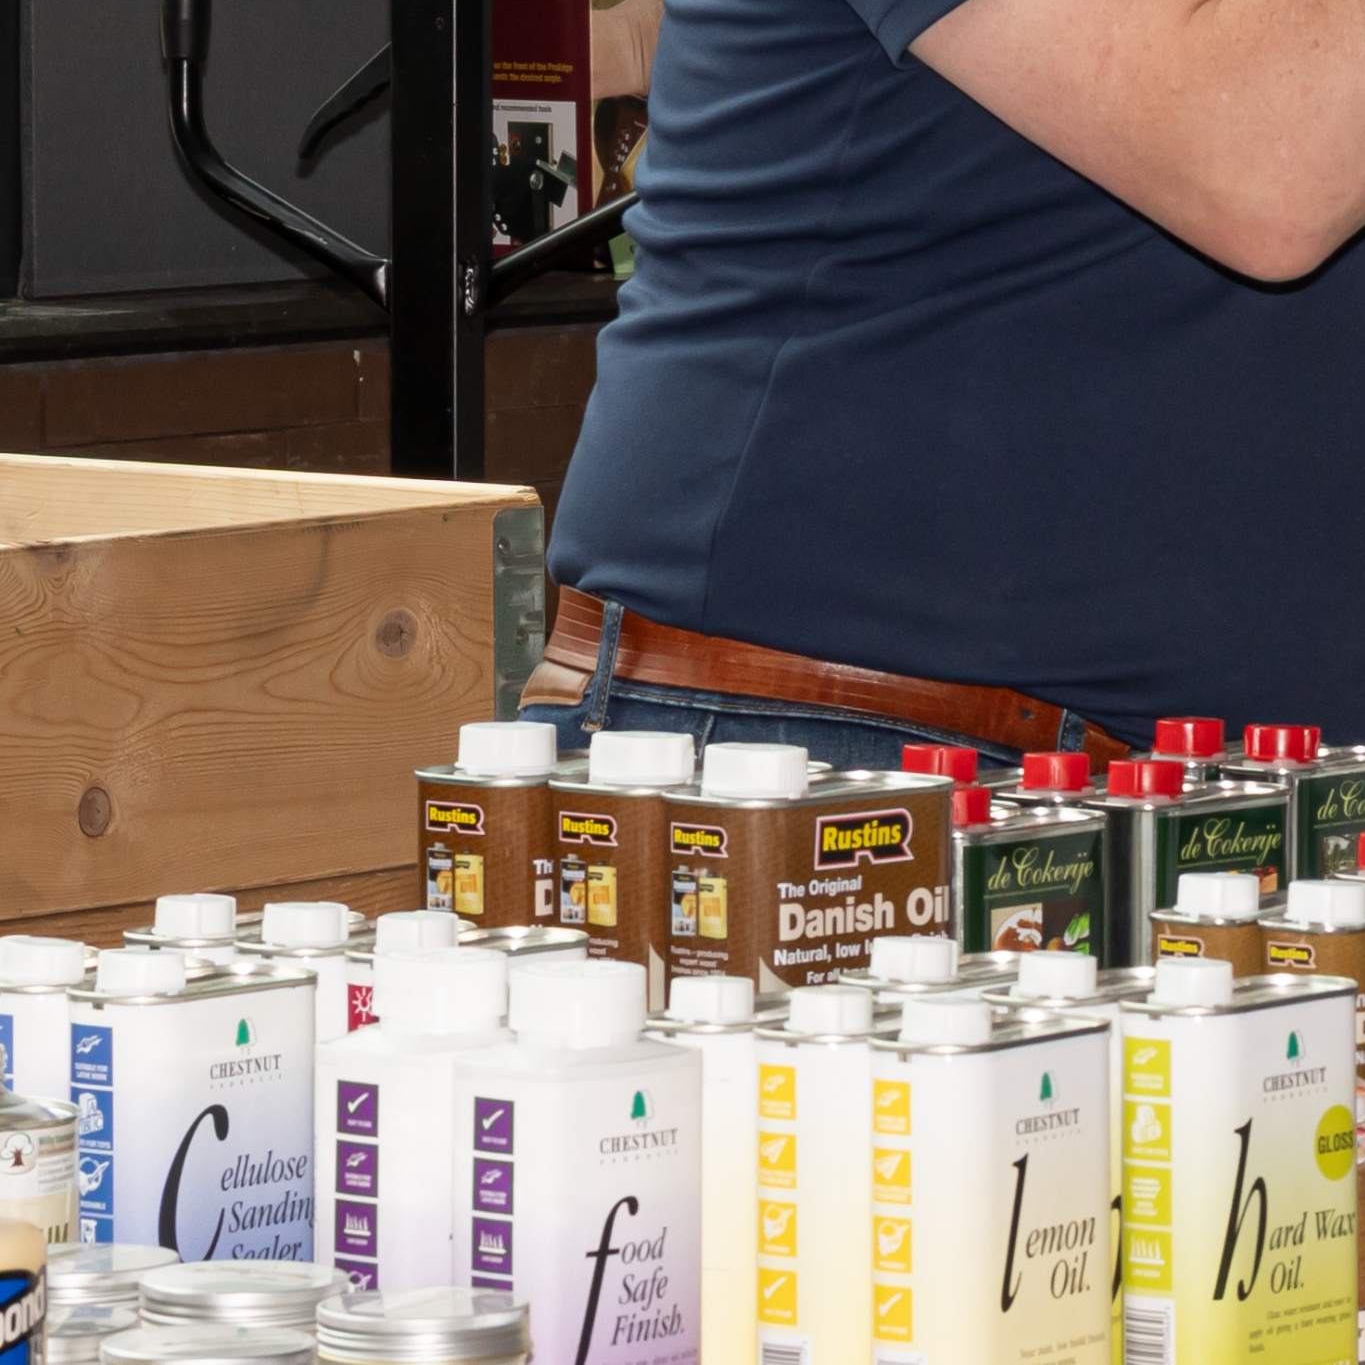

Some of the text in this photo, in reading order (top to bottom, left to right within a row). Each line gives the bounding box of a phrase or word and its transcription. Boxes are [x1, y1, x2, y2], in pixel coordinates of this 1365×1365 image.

[429, 807, 476, 824] Rustins
[562, 817, 609, 836] Rustins
[674, 829, 720, 847] Rustins
[823, 820, 902, 852] Rustins
[1181, 829, 1201, 861] de
[777, 875, 863, 899] The Original
[988, 860, 1013, 891] de
[779, 885, 950, 942] Danish Oil
[773, 942, 860, 966] Natural, low
[1160, 938, 1198, 954] Rustins
[1270, 945, 1308, 961] Rustins
[806, 971, 824, 984] For
[210, 1054, 282, 1081] CHESTNUT
[1263, 1067, 1327, 1093] CHESTNUT
[1016, 1108, 1080, 1135] CHESTNUT
[600, 1128, 678, 1155] CHESTNUT
[1318, 1130, 1354, 1154] GLOSS
[1315, 1208, 1356, 1242] Wax
[618, 1266, 668, 1311] Safe
[1050, 1251, 1090, 1299] Oil.
[1270, 1256, 1304, 1294] Oil.
